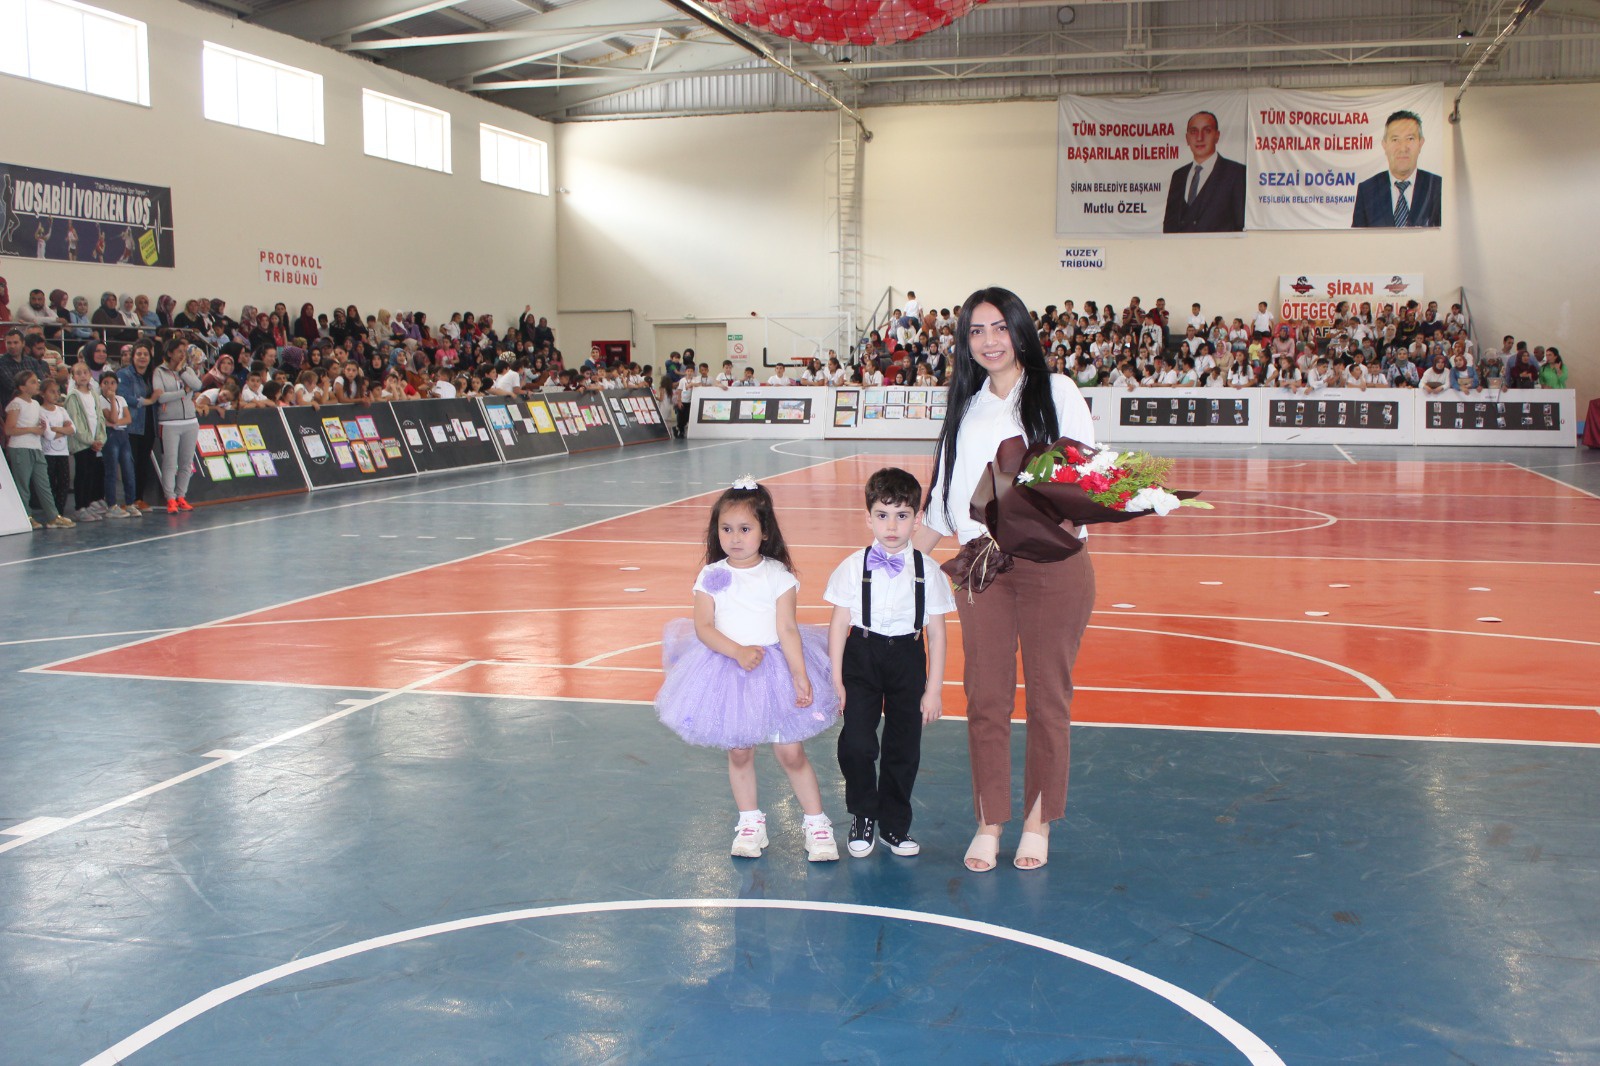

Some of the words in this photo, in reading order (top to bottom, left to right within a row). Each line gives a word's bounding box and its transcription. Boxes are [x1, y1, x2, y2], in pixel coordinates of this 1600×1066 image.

[1260, 108, 1285, 124] TÜM
[1289, 111, 1369, 125] SPORCULARA
[1072, 120, 1096, 136] TÜM
[1099, 122, 1175, 137] SPORCULARA
[1255, 136, 1320, 154] BAŞARILAR
[1324, 133, 1373, 151] DİLERİM
[1067, 146, 1130, 163] BAŞARILAR
[1132, 143, 1179, 160] DİLERİM
[1259, 169, 1299, 186] SEZAİ
[1304, 168, 1355, 186] DOĞAN
[1071, 181, 1092, 194] ŞİRAN
[1094, 181, 1127, 192] BELEDİYE
[1129, 182, 1161, 194] BAŞKANI
[14, 180, 125, 222] KOŞABİLİYORKEN
[126, 195, 152, 230] KOŞ
[1083, 202, 1114, 213] Mutlu
[1117, 200, 1147, 213] ÖZEL
[1292, 195, 1324, 203] BELEDİYE
[1325, 195, 1355, 204] BAŞKANI
[260, 250, 322, 269] PROTOKOL
[1065, 249, 1098, 257] KUZEY
[1060, 259, 1103, 268] TRİBÜNÜ
[265, 269, 318, 286] TRİBÜNÜ
[1326, 279, 1374, 299] ŞİRAN
[1282, 299, 1338, 324] ÖTEGEÇ
